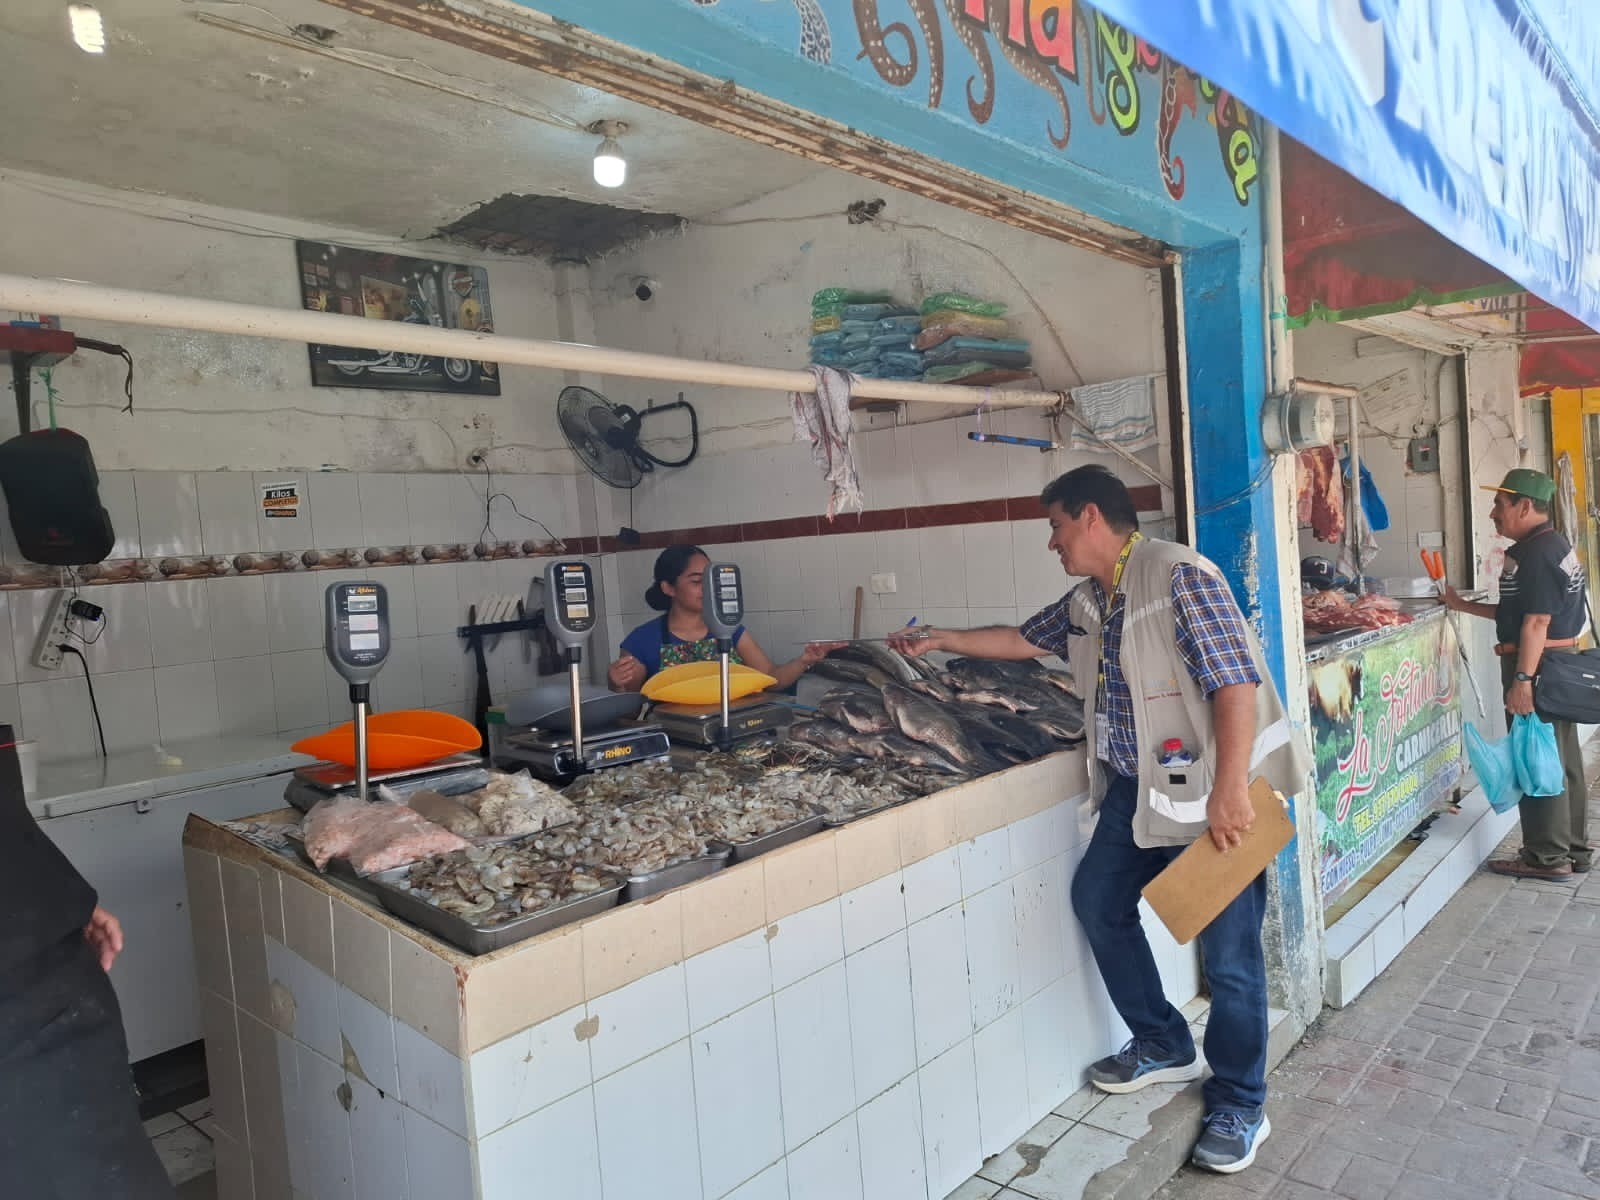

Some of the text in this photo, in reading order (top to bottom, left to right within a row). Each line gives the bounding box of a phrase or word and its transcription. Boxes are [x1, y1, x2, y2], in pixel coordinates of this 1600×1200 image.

[604, 745, 632, 759] RHINO
[1336, 709, 1376, 826] La
[1376, 658, 1455, 774] Fortuna
[1396, 709, 1459, 773] CARNICERIA
